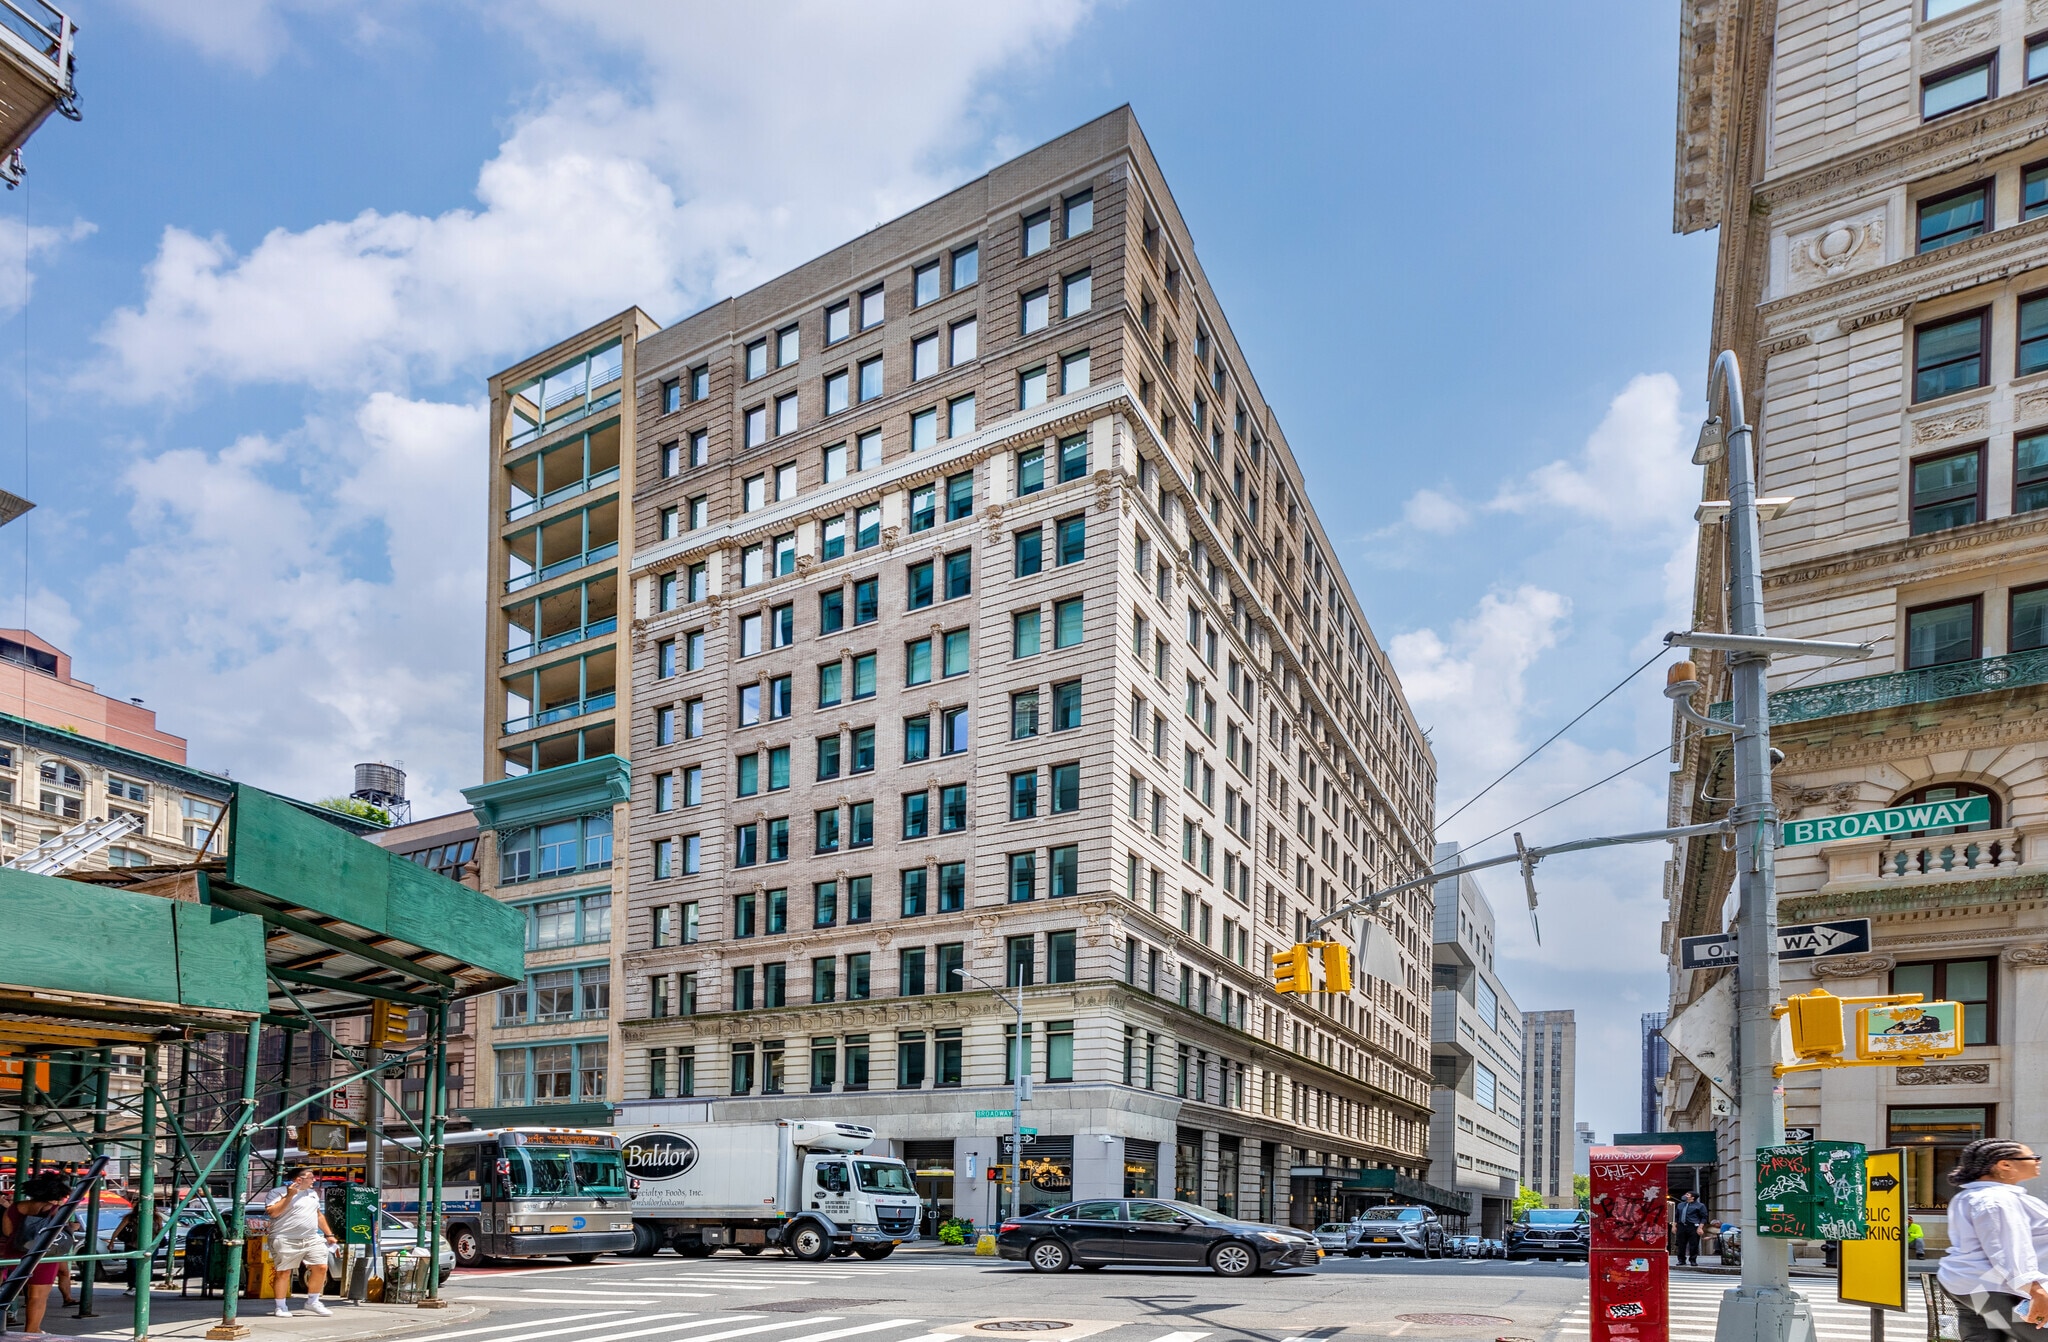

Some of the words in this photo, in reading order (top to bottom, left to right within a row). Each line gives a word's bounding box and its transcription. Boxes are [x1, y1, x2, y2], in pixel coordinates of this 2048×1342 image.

[1795, 801, 1972, 842] BROADWAY
[1784, 933, 1838, 949] WAY
[627, 1143, 690, 1167] Baldor
[638, 1187, 663, 1198] ecialty
[689, 1189, 704, 1197] Inc.
[1865, 1207, 1890, 1222] BLIC
[1867, 1226, 1900, 1241] KING
